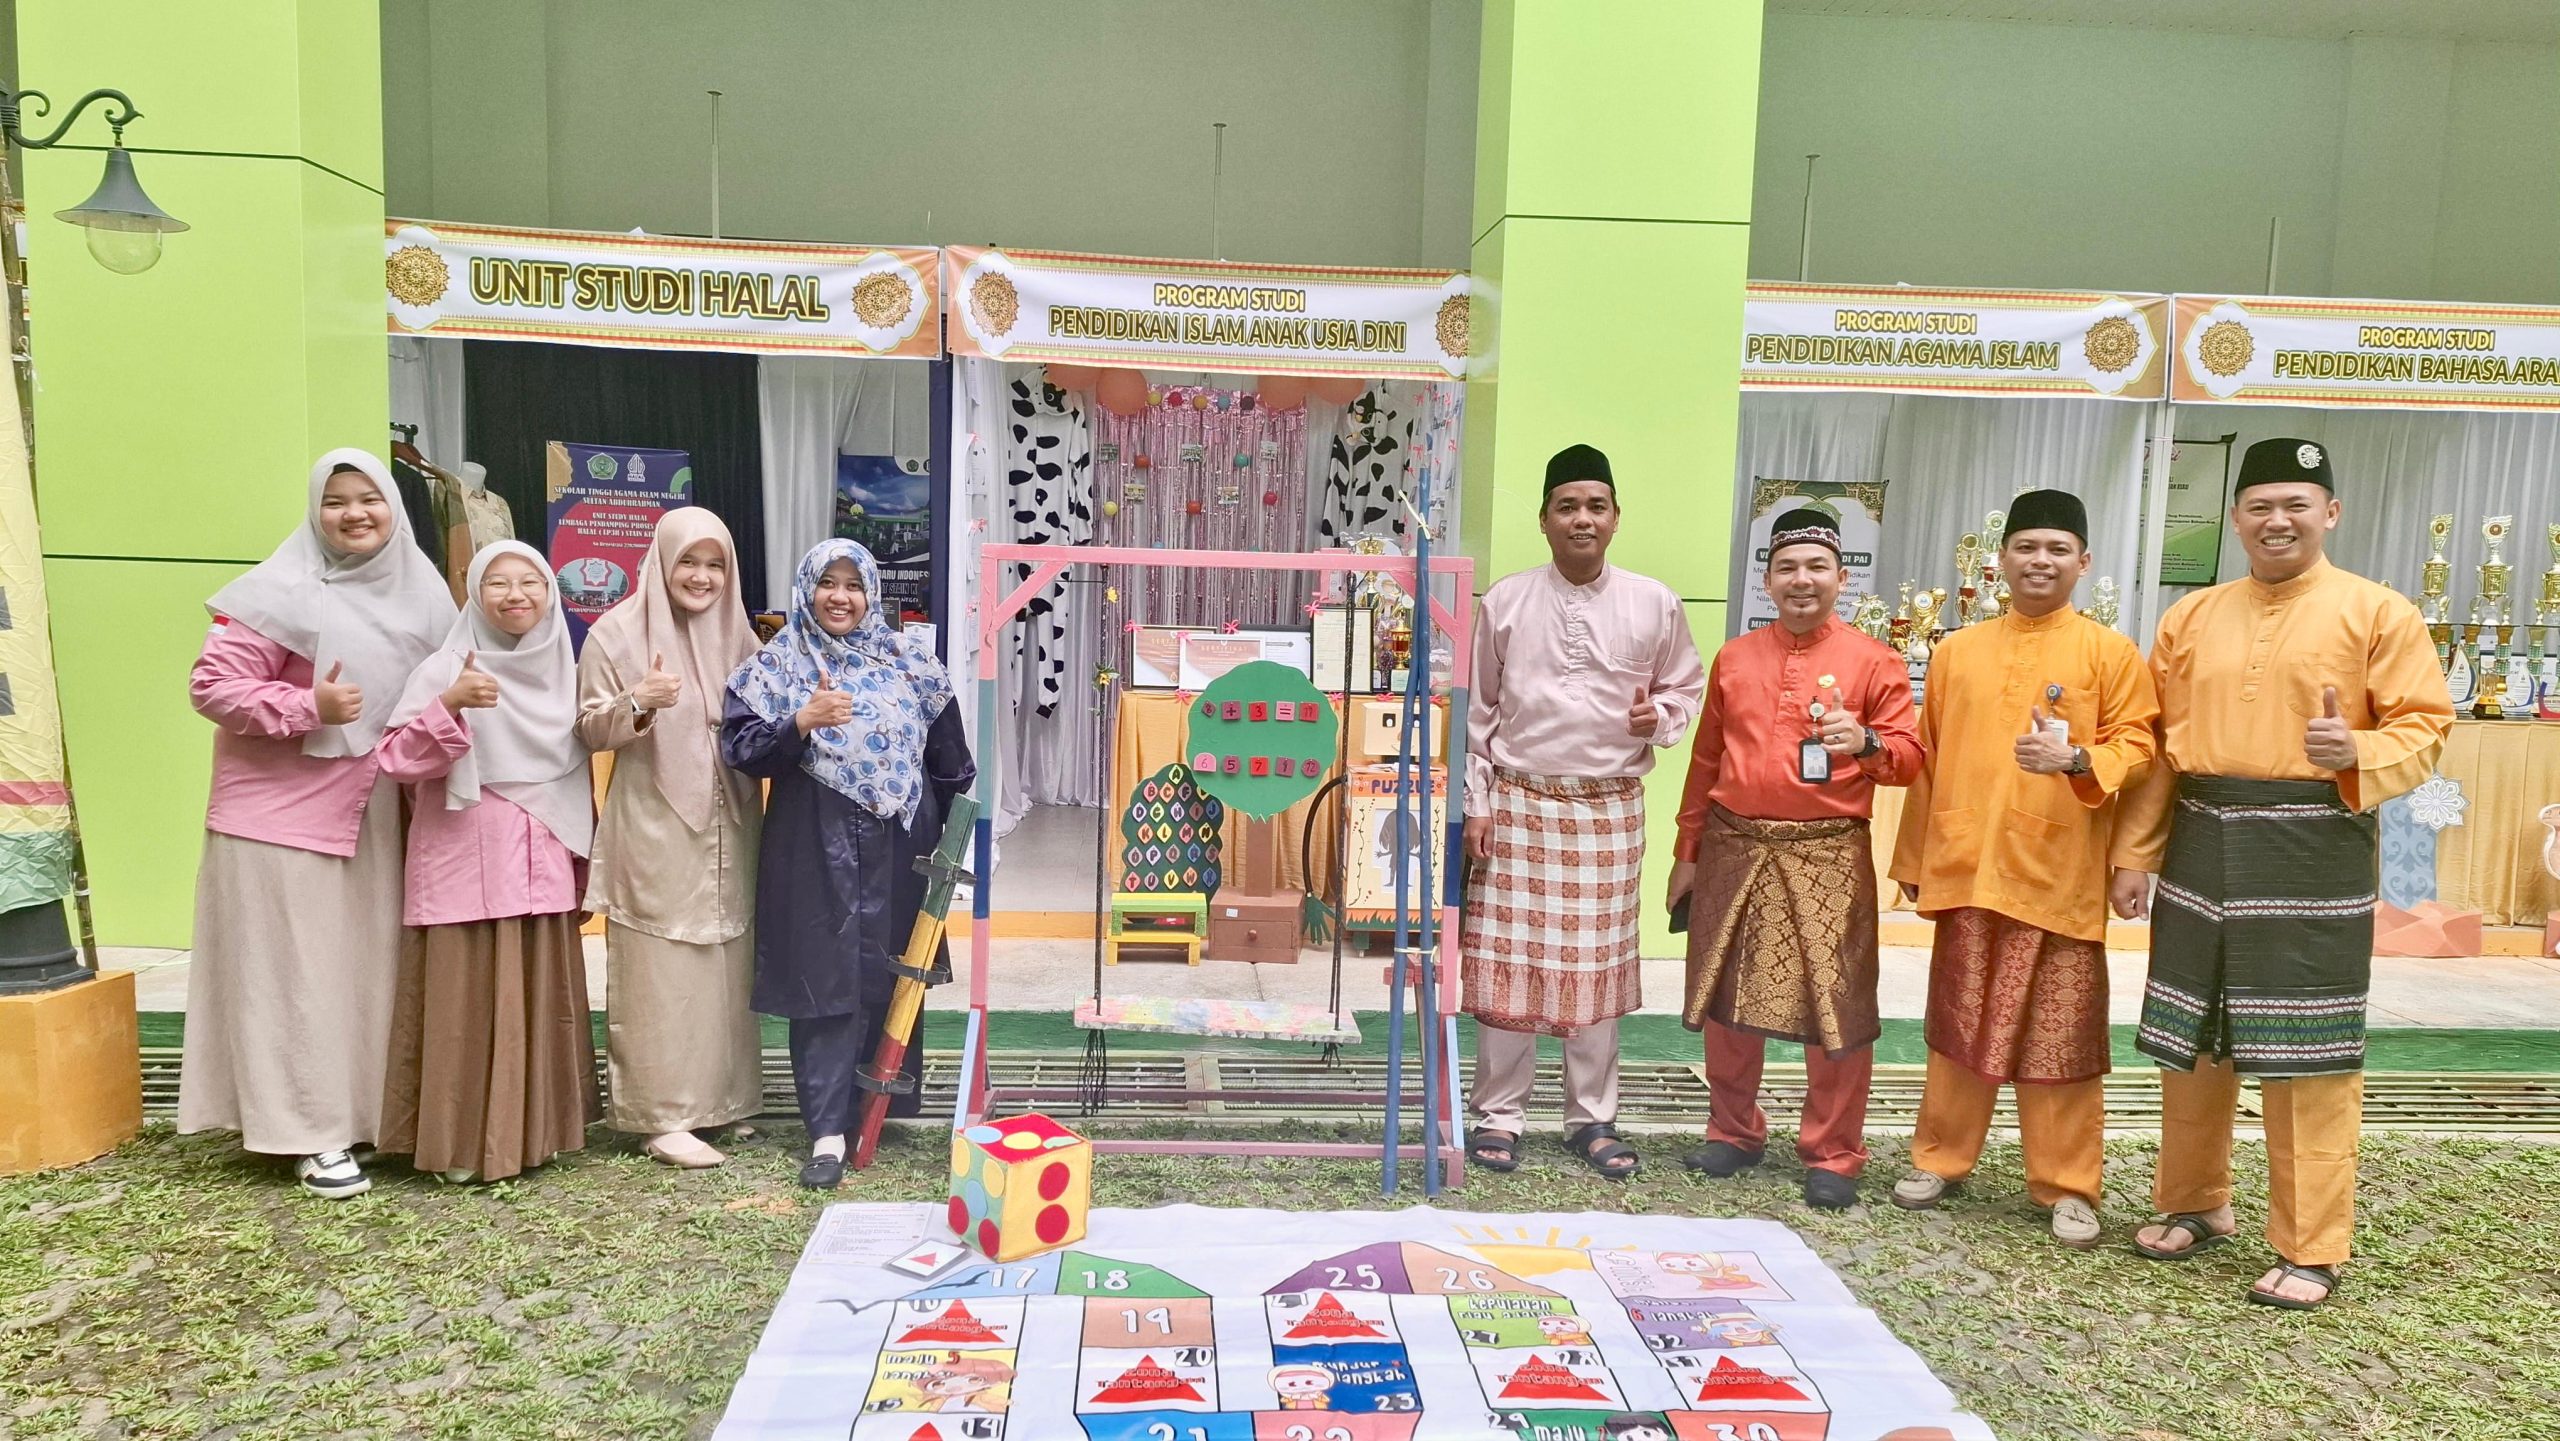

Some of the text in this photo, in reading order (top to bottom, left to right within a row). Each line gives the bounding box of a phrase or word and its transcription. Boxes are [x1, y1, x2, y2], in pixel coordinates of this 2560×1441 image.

[471, 258, 829, 320] UNIT STUDI HALAL
[1155, 285, 1304, 311] PROGRAM STUDI
[1049, 307, 1406, 352] PENDIDIKAN ISLAM ANAK USIA DINI
[1835, 310, 1977, 334] PROGRAM STUDI
[2359, 326, 2495, 351] PROGRAM STUDI
[1746, 334, 2060, 370] PENDIDIKAN AGAMA ISLAM
[2274, 350, 2560, 385] PENDIDIKAN BAHASA ARA
[554, 486, 685, 500] SEKOLAH TINGGI AGAMA ISLAM NEGERI
[1854, 555, 1868, 563] PAI
[898, 570, 930, 580] INDONES
[1172, 769, 1180, 780] A
[1148, 786, 1156, 797] B
[1164, 787, 1171, 797] C
[1136, 806, 1144, 817] D
[1174, 807, 1182, 817] H
[1142, 828, 1150, 839] K
[1182, 828, 1192, 838] M
[1150, 850, 1158, 861] P
[1208, 848, 1217, 859] S
[1129, 877, 1137, 888] T
[1148, 875, 1155, 885] U
[1168, 875, 1175, 885] V
[990, 1268, 1038, 1288] 17
[1082, 1270, 1130, 1290] 18
[1325, 1264, 1383, 1290] 25
[1435, 1267, 1496, 1290] 26
[1121, 1307, 1172, 1334] 19
[1631, 1308, 1644, 1321] 6
[1461, 1329, 1498, 1344] 27
[1646, 1334, 1689, 1349] 32
[946, 1351, 961, 1364] 5
[1175, 1348, 1213, 1367] 20
[1336, 1369, 1407, 1385] langkah
[1374, 1392, 1416, 1411] 23
[963, 1418, 1000, 1438] 14
[1486, 1412, 1530, 1429] 29
[1534, 1424, 1586, 1441] maju
